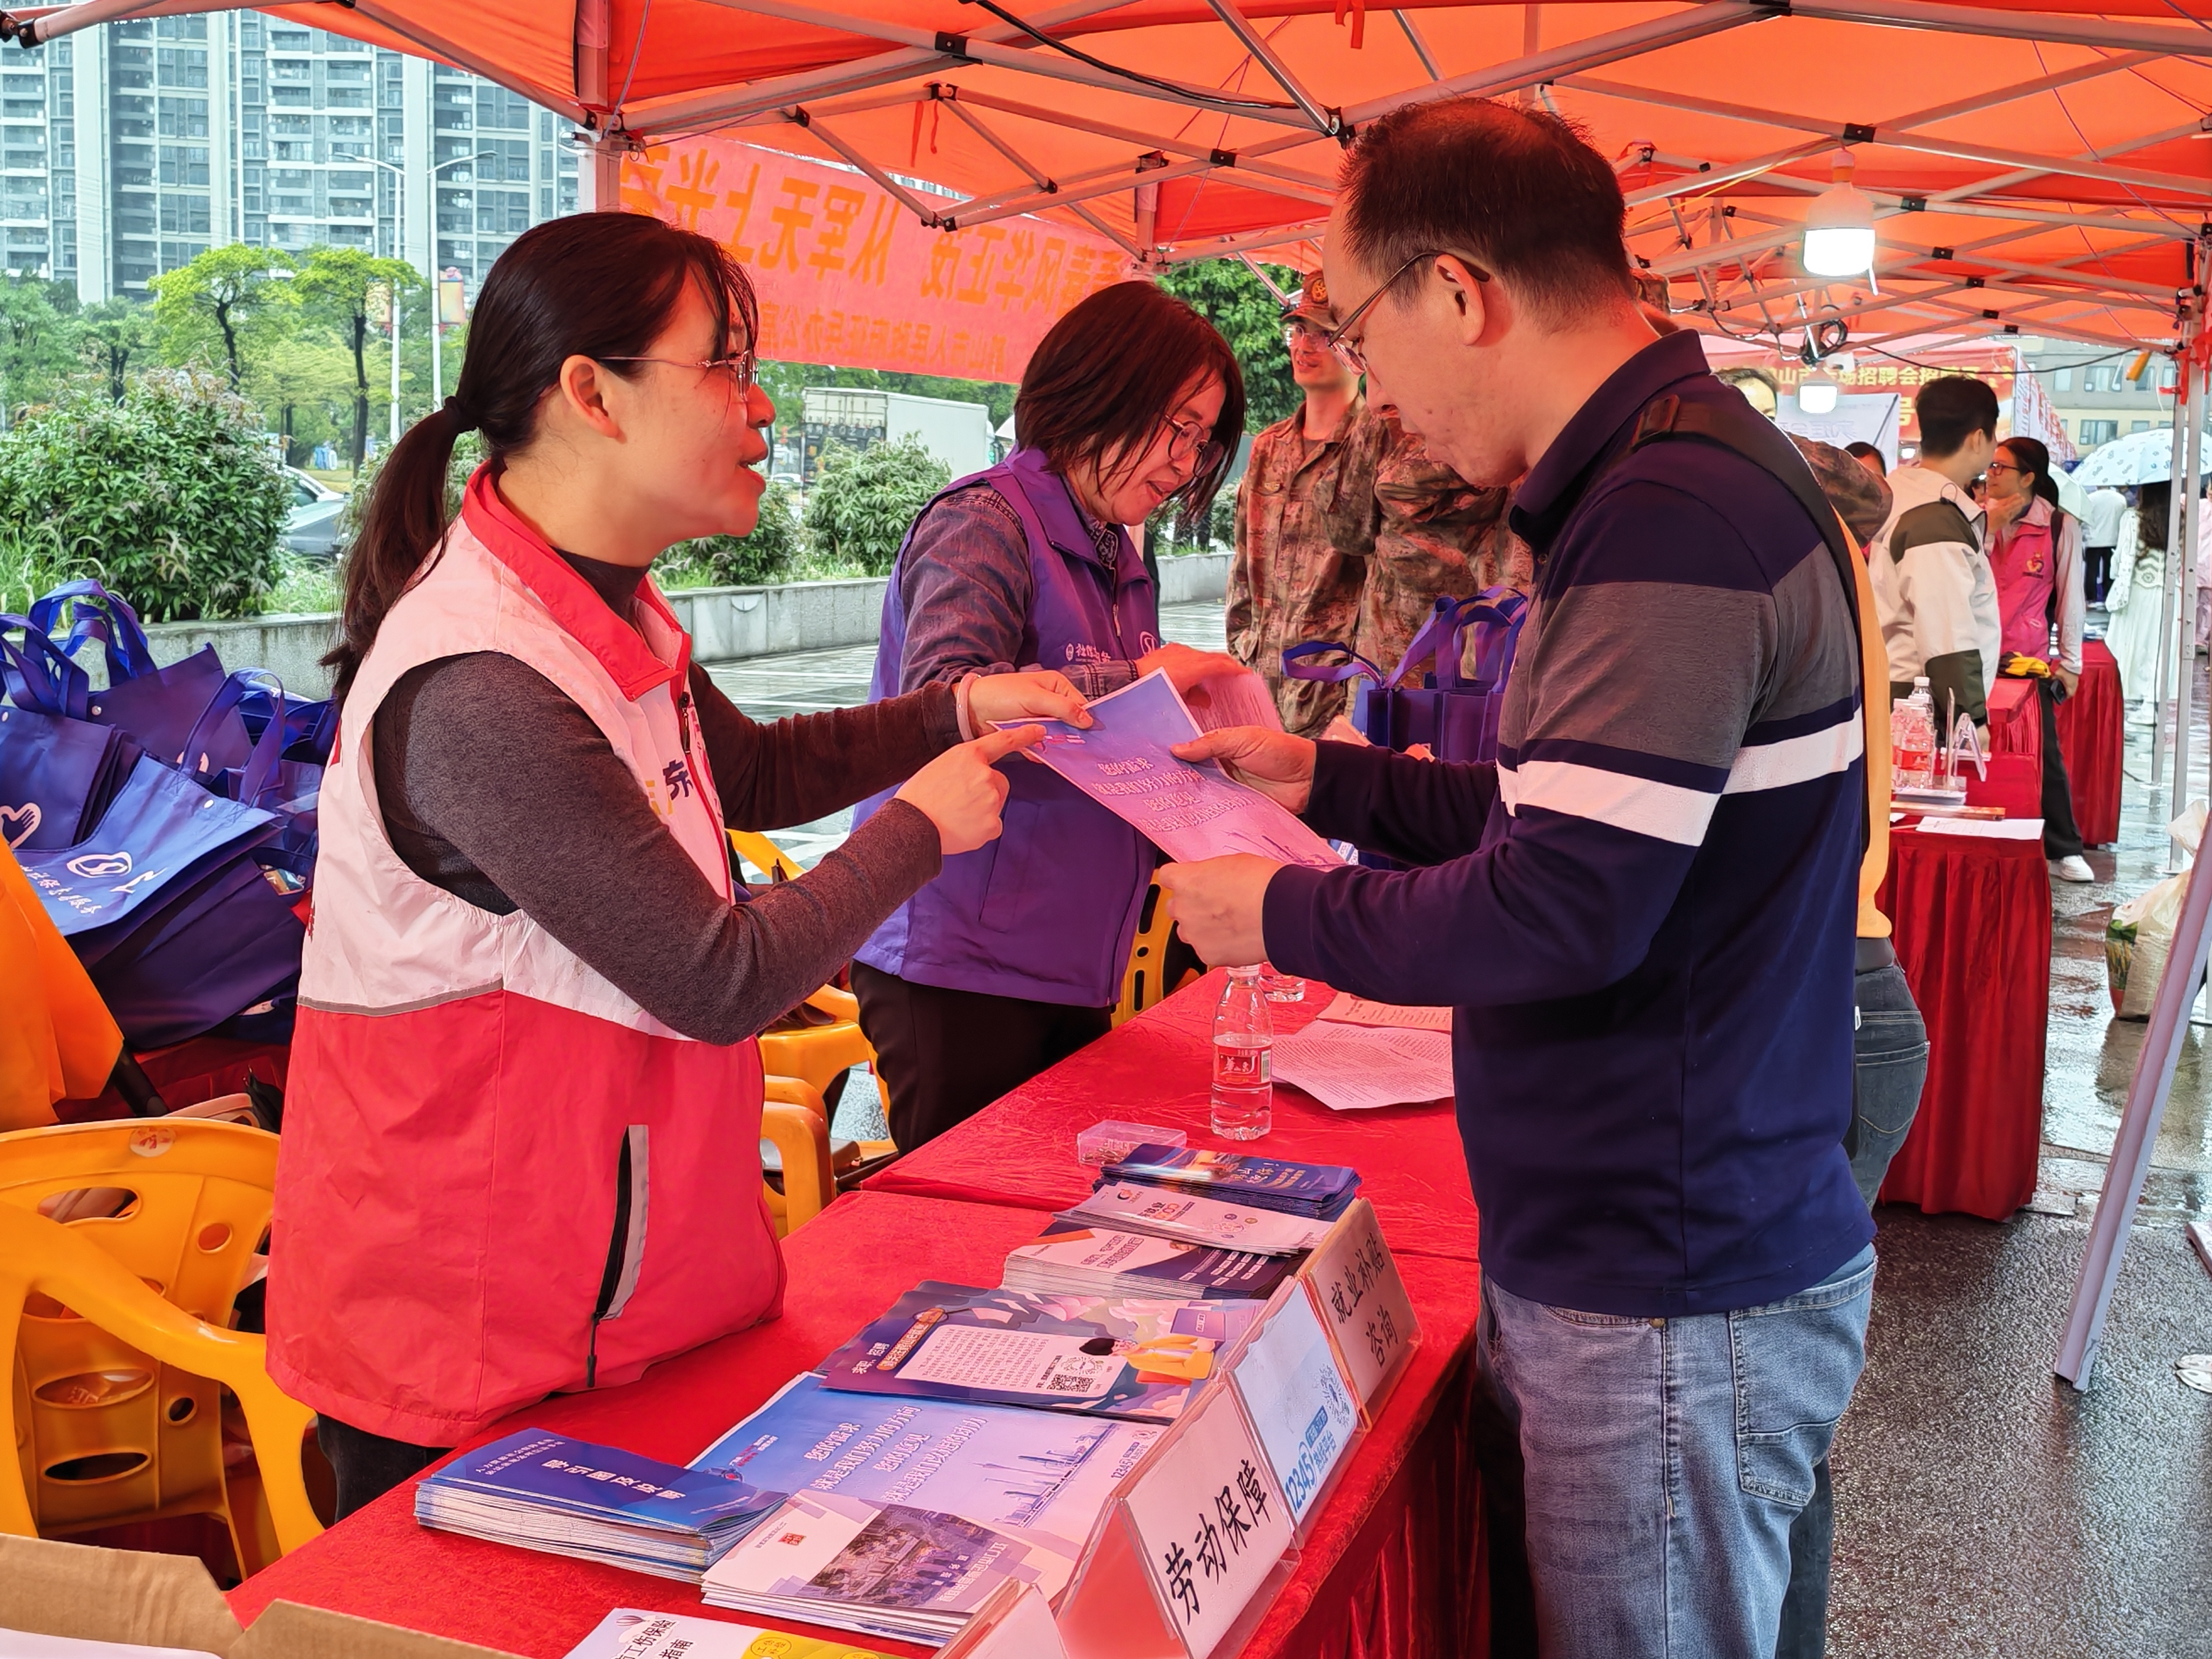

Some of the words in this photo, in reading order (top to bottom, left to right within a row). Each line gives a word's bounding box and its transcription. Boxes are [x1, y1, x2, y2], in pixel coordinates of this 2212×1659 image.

[1331, 1232, 1385, 1325] 就业补贴
[1366, 1304, 1399, 1368] 咨询
[804, 1421, 863, 1462] 您的需求
[810, 1405, 922, 1491] 就是我们努力的方向
[872, 1432, 932, 1473] 您的意见
[879, 1417, 988, 1503] 就是我们改进的动力
[1284, 1451, 1316, 1513] 12345
[1164, 1458, 1272, 1627] 劳动保障
